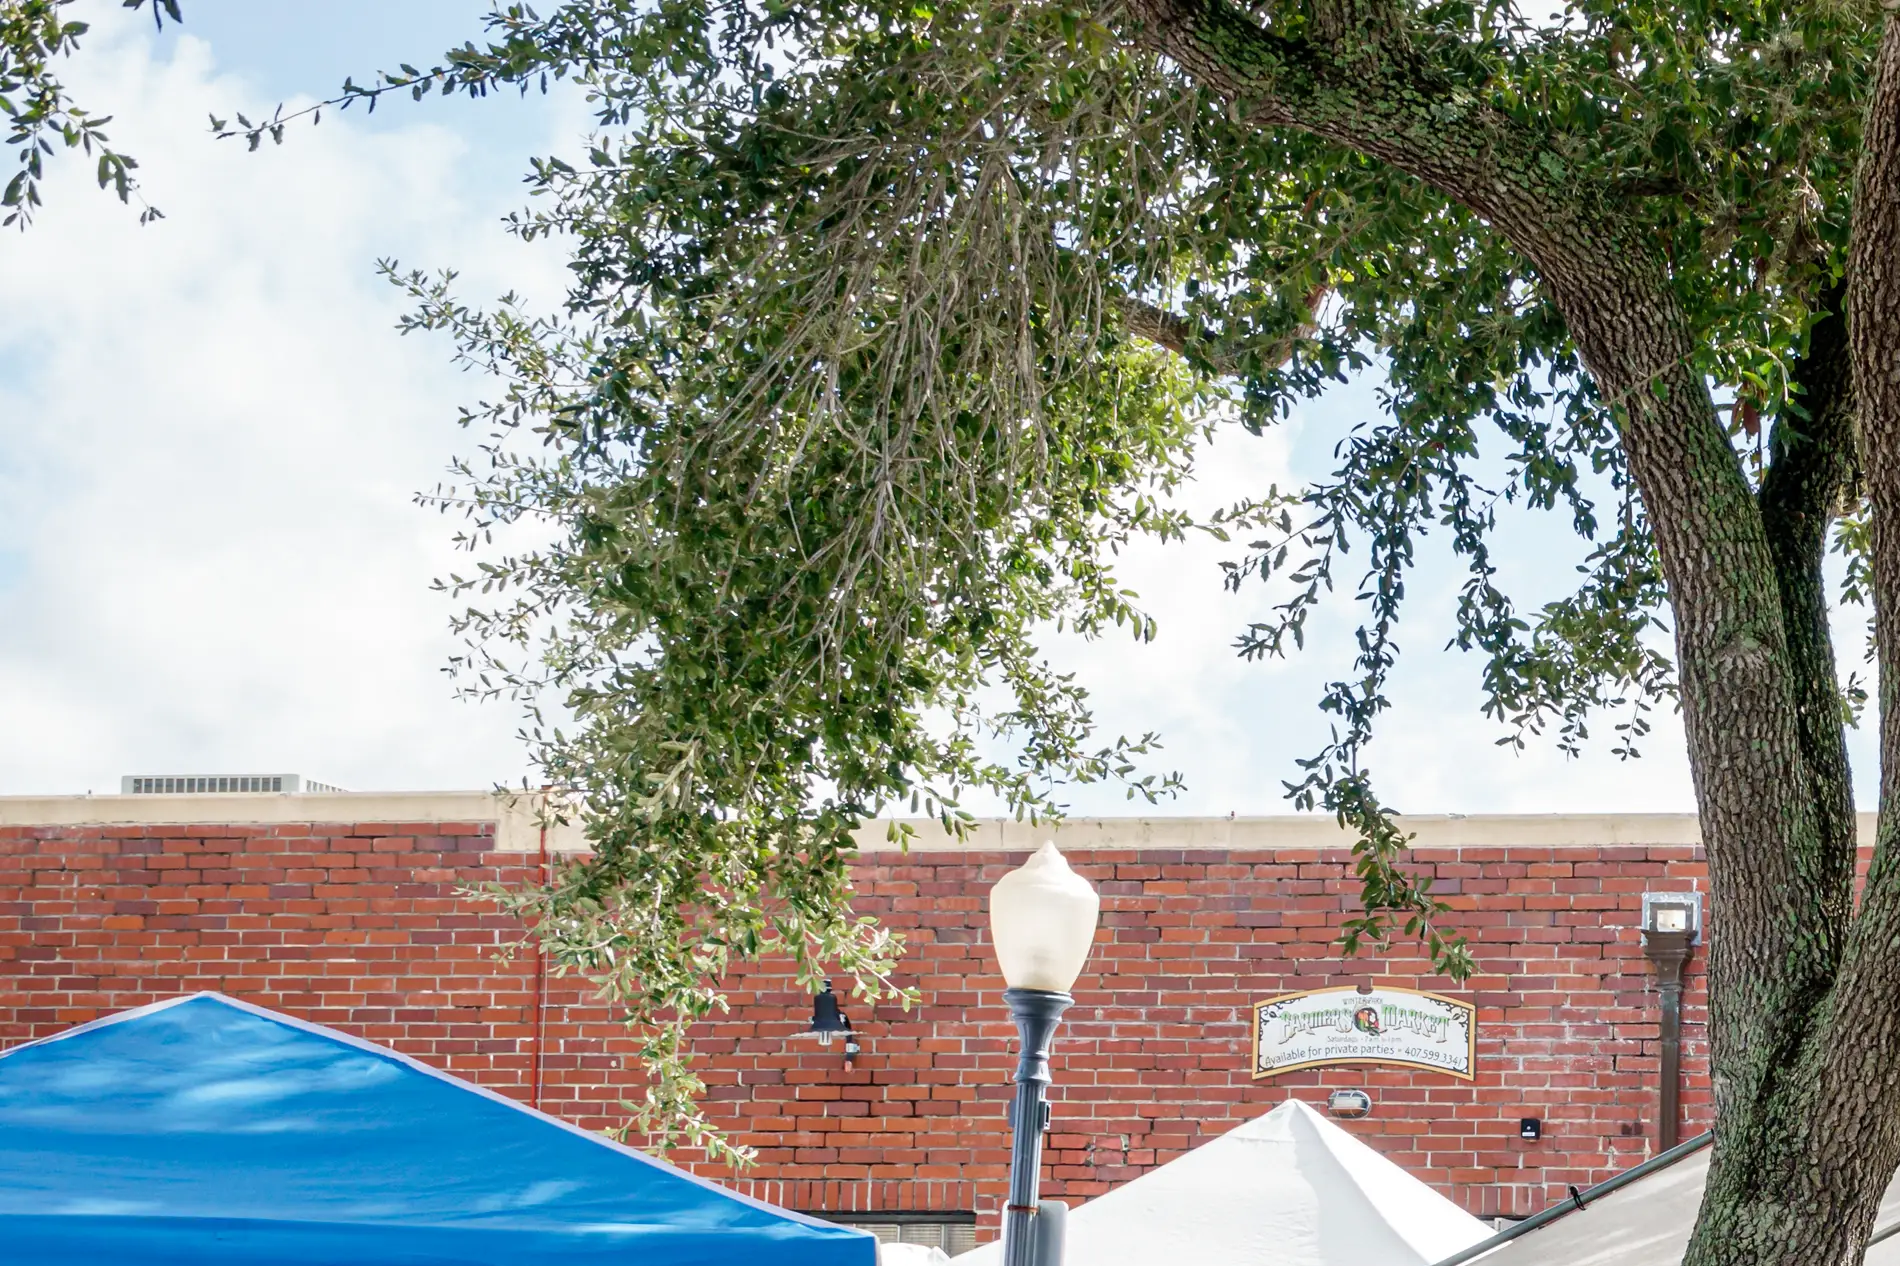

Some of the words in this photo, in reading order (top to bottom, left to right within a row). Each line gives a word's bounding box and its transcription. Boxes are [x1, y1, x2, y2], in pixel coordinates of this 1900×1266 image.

[1278, 1008, 1353, 1045] FARMERS
[1380, 1003, 1450, 1044] MARKET
[1265, 1047, 1305, 1067] Available
[1307, 1046, 1322, 1059] for
[1325, 1043, 1358, 1057] private
[1361, 1044, 1395, 1056] parties
